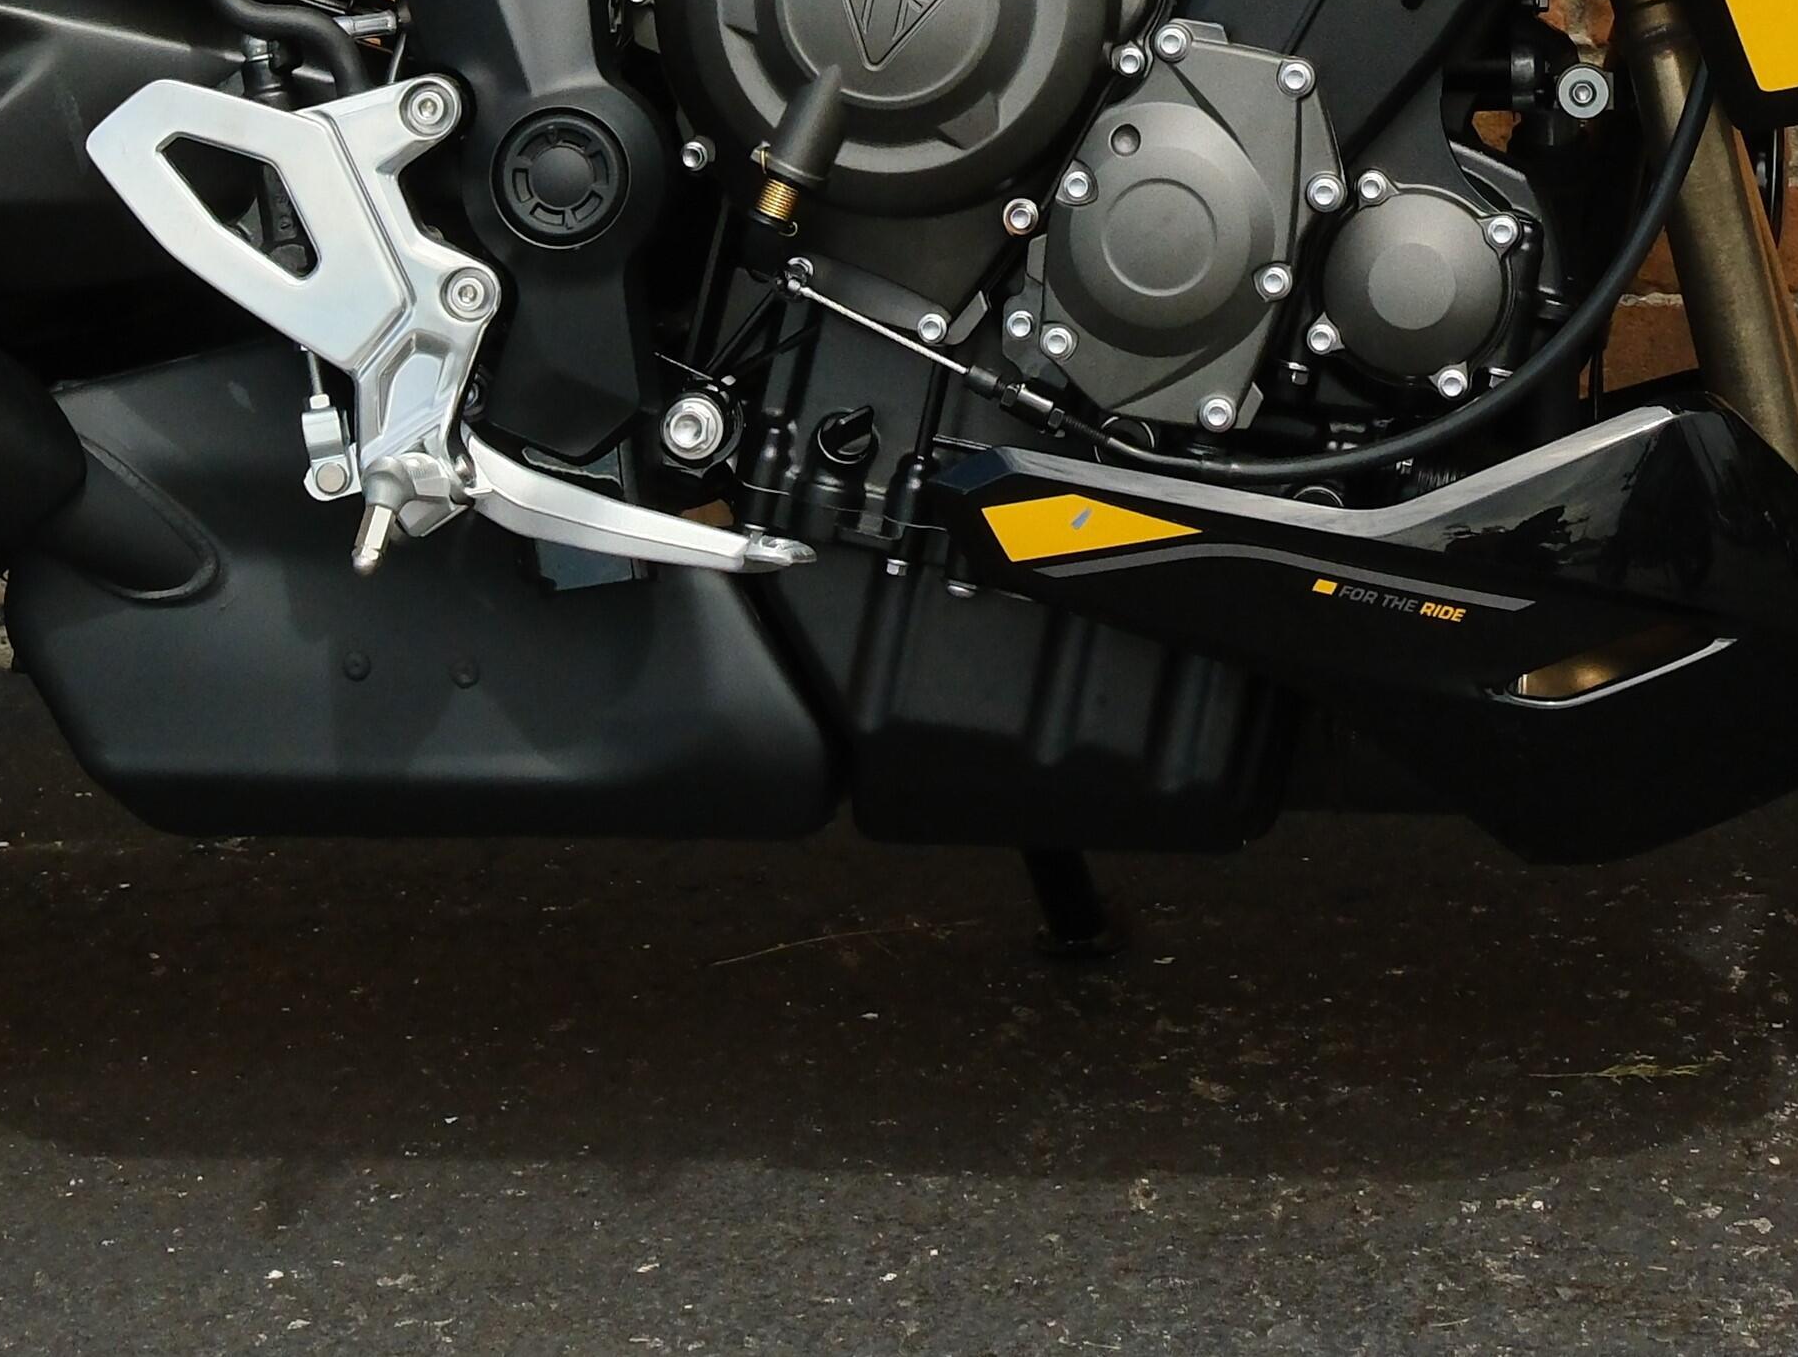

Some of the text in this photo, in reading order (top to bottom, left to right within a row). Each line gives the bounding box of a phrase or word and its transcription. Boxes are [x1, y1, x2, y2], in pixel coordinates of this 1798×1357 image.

[1338, 585, 1467, 623] FOR THE RIDE
